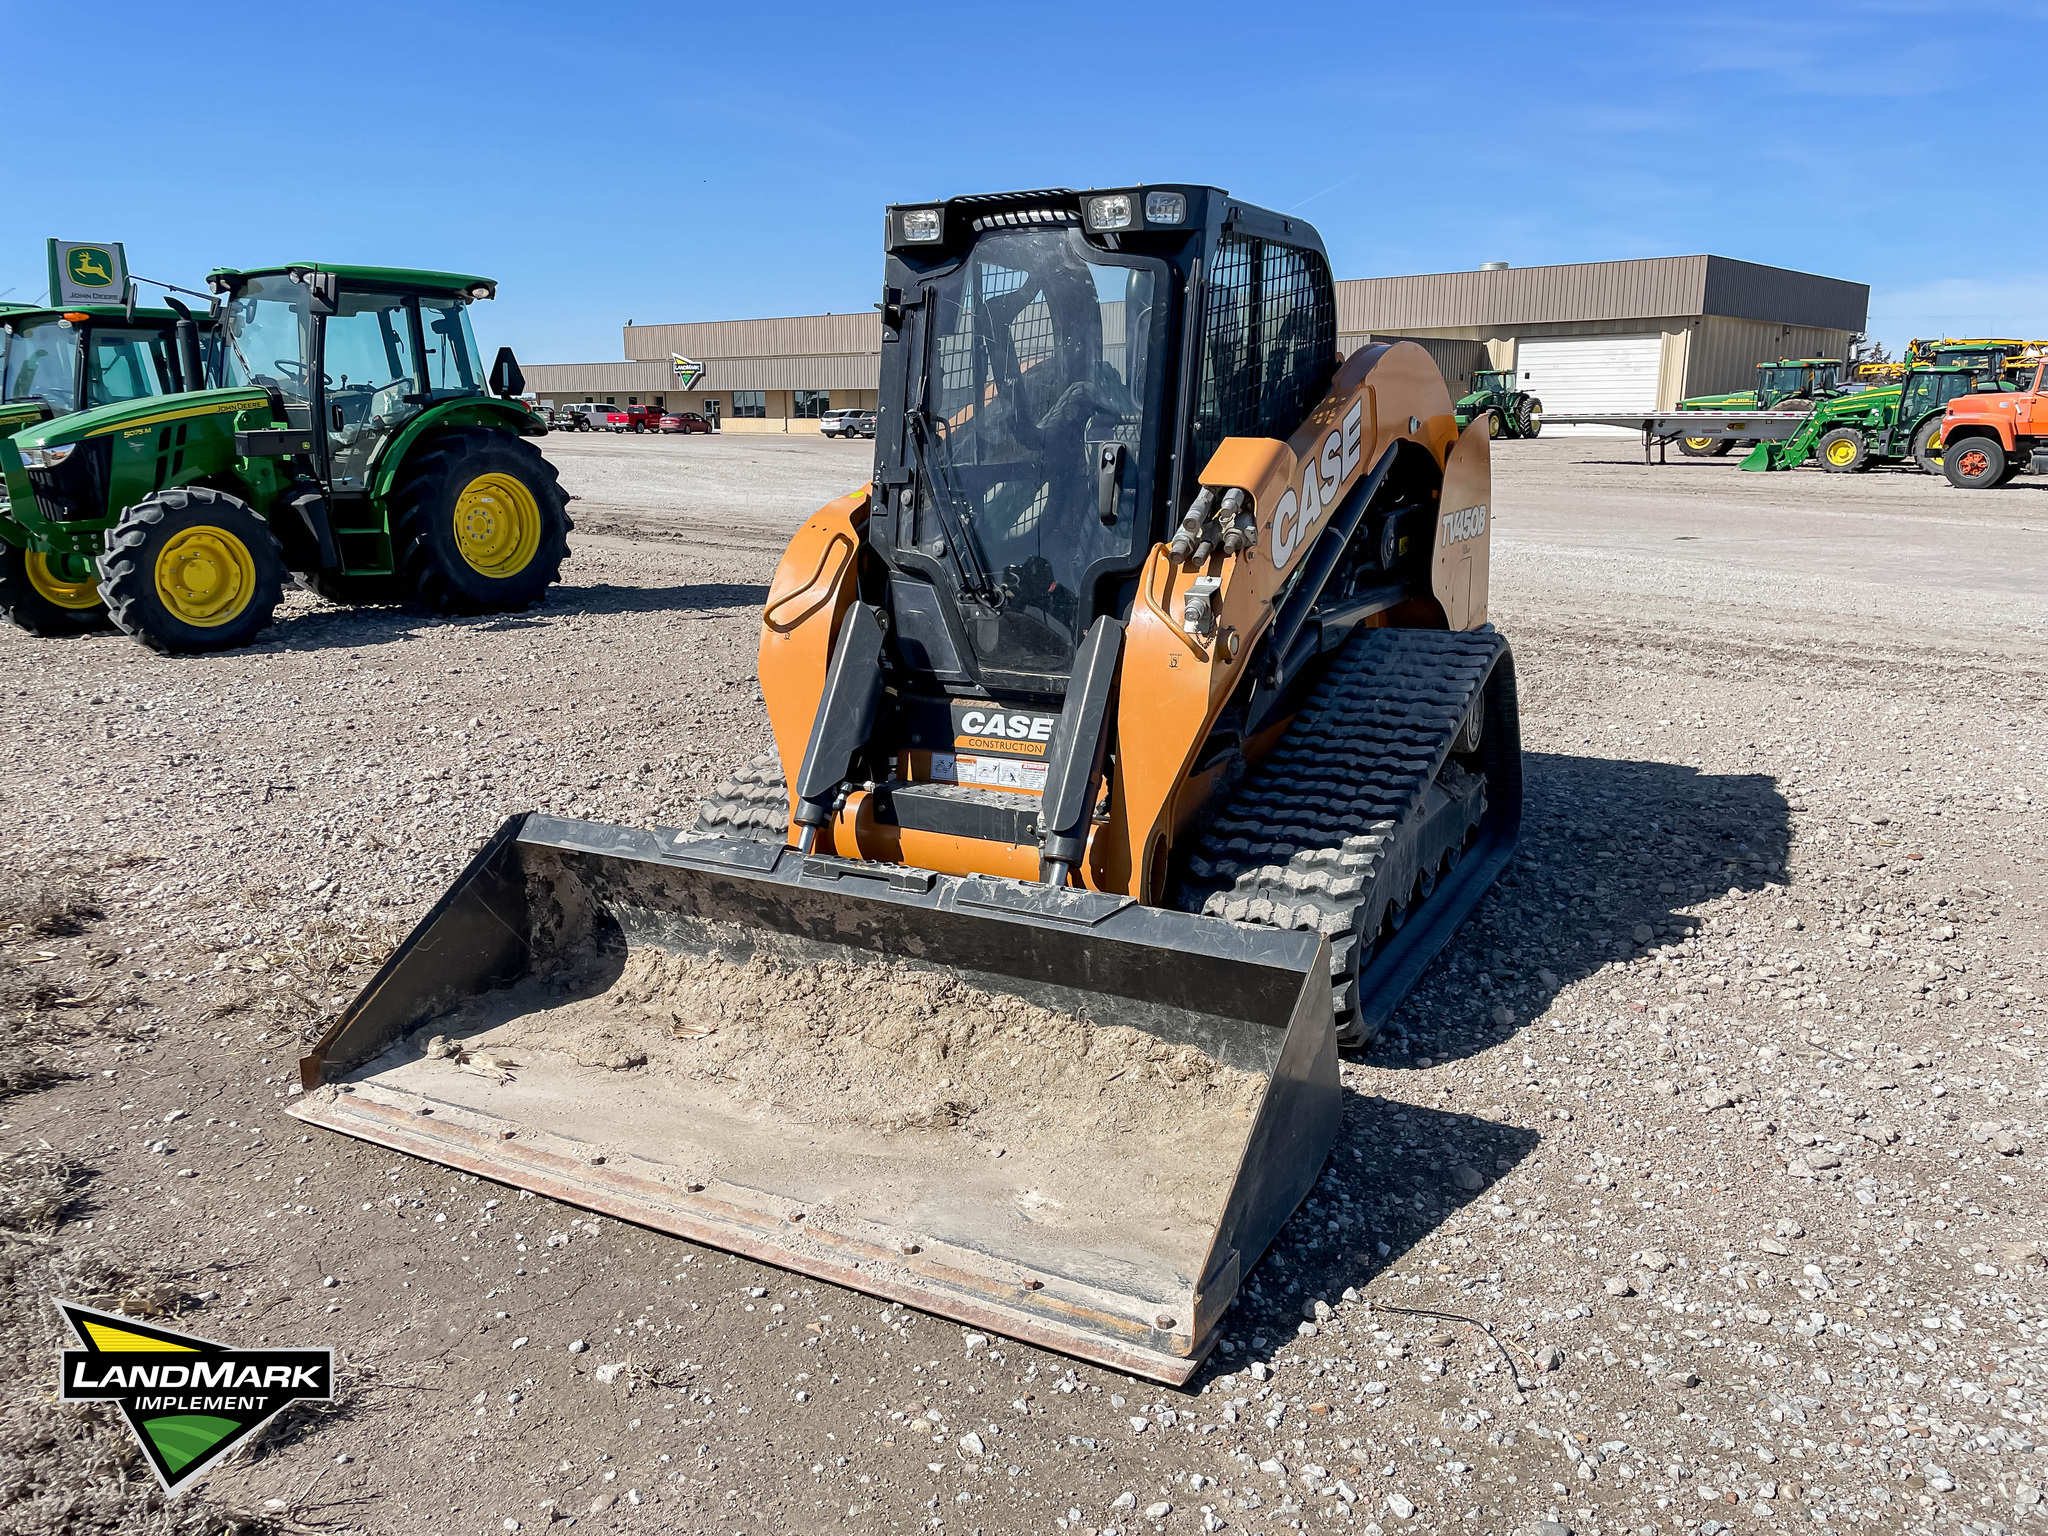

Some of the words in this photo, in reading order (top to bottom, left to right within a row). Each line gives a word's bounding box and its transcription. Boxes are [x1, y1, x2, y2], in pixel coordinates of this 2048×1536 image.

[92, 292, 119, 300] DEERE
[216, 404, 236, 413] JOHN
[237, 402, 262, 410] DEERE
[1271, 397, 1362, 571] CASE
[1442, 505, 1487, 548] TV450B
[961, 711, 1054, 740] CASE
[968, 738, 1042, 753] CONSTRUCTION
